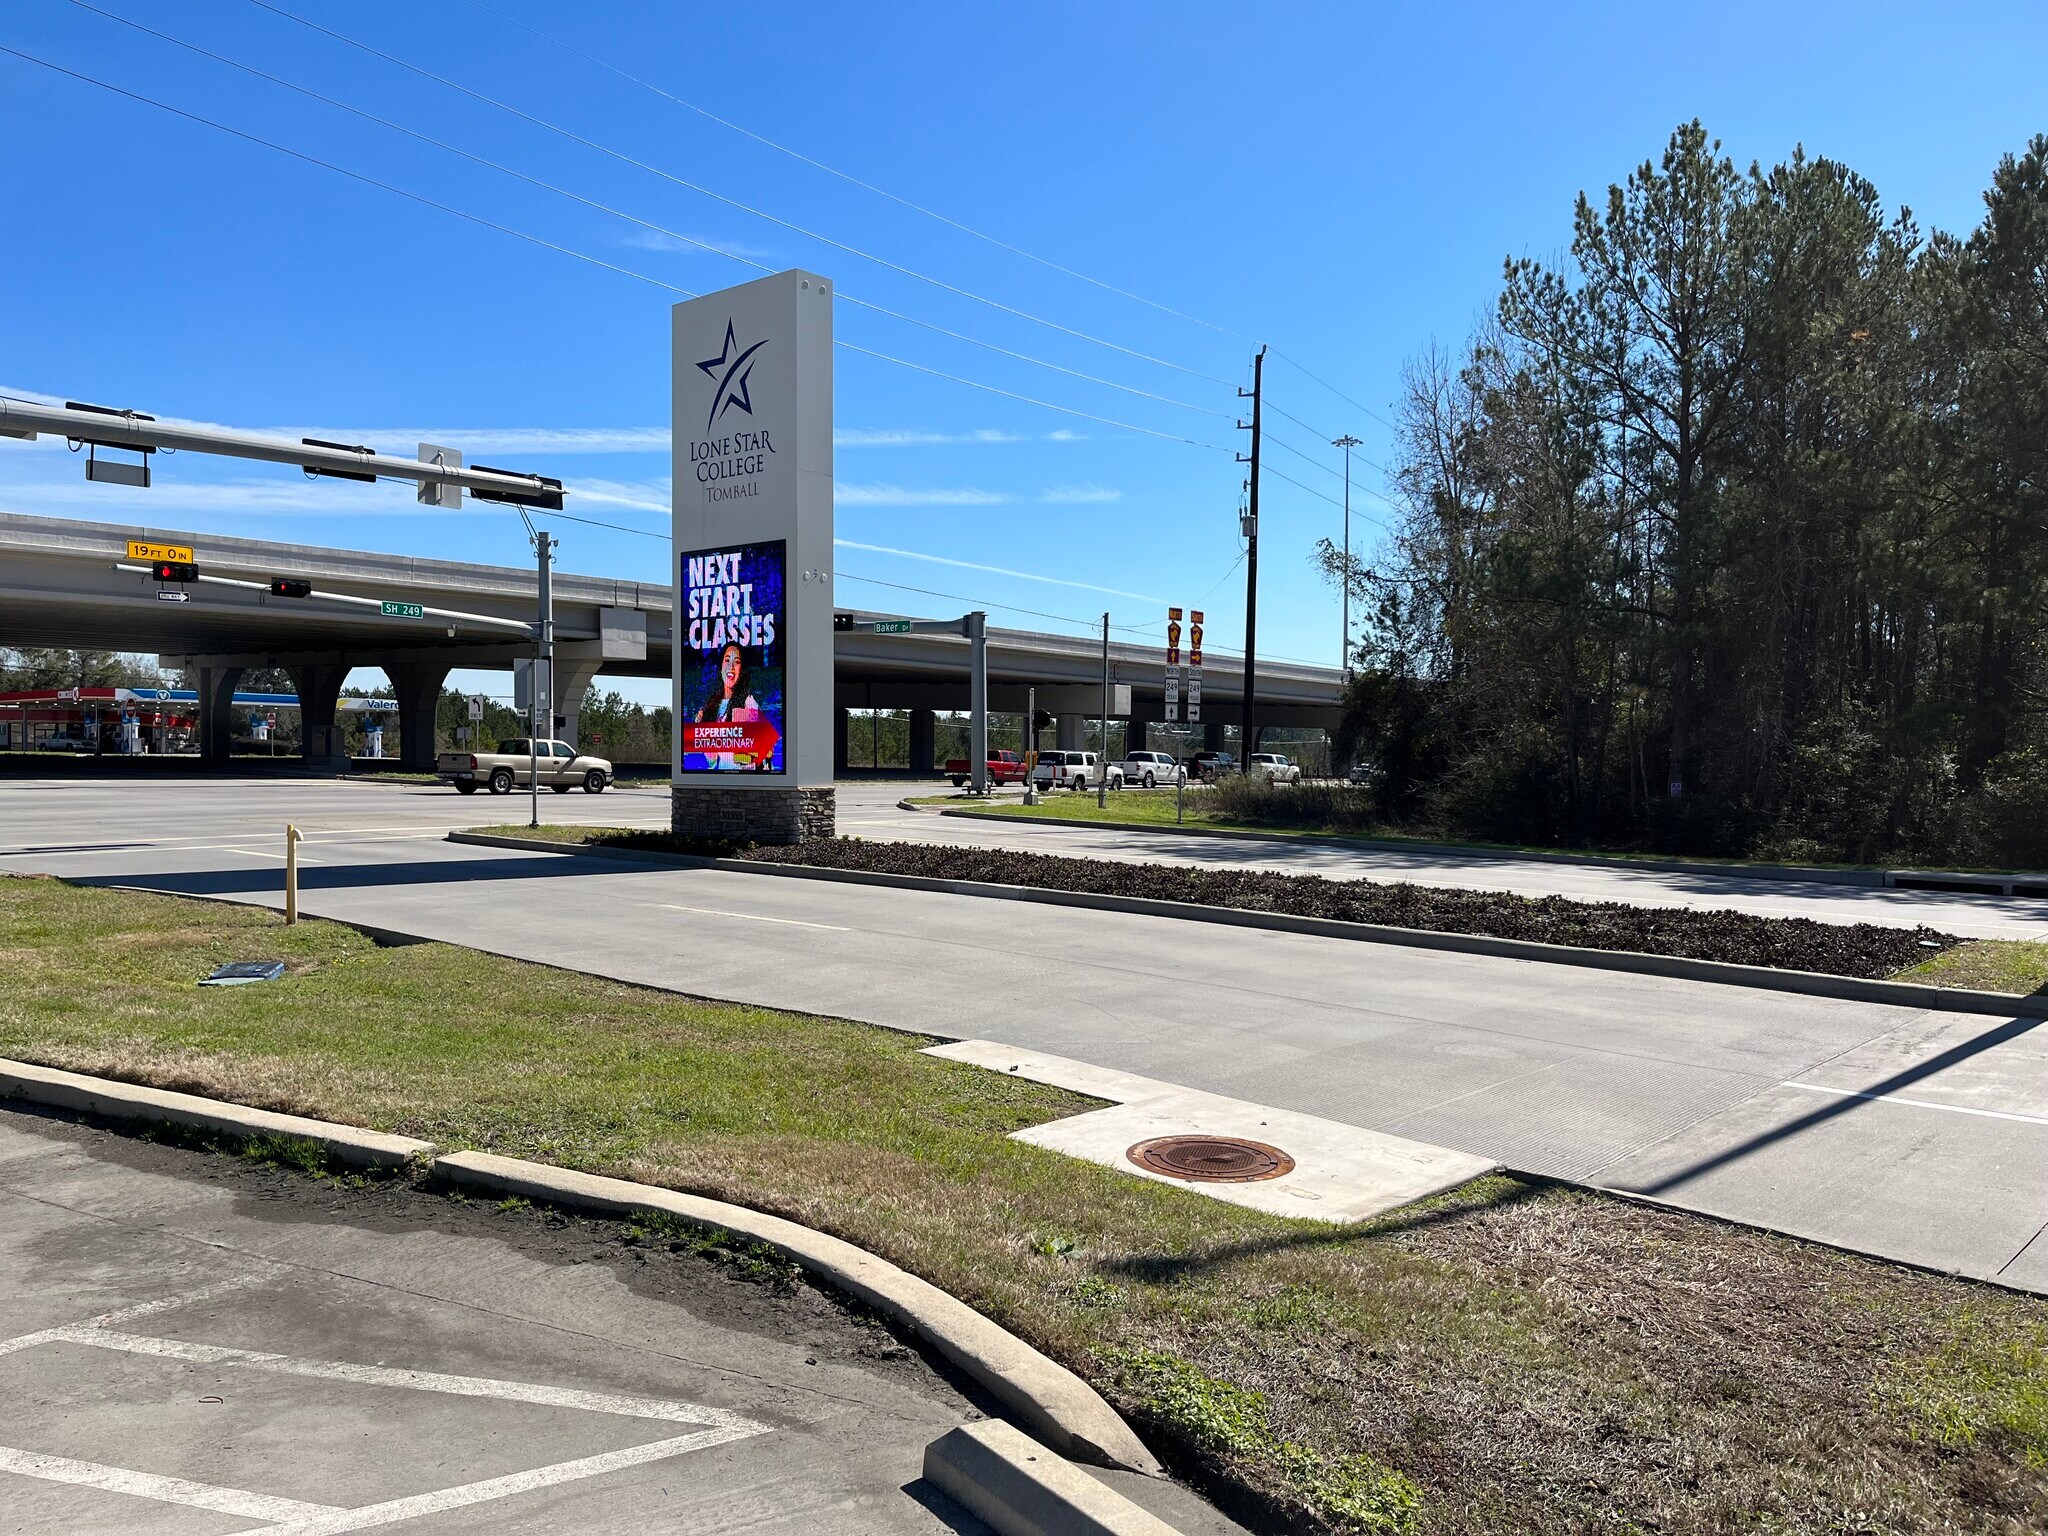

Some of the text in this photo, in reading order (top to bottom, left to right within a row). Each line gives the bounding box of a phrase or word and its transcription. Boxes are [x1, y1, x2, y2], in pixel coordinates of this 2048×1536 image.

[690, 430, 776, 462] LONE STAR
[697, 454, 764, 482] COLLEGE
[706, 482, 760, 503] TOMBALL
[134, 545, 148, 556] 19
[168, 549, 176, 559] 0
[689, 552, 742, 588] NEXT
[689, 583, 752, 619] START
[386, 604, 420, 616] SH 249
[689, 613, 775, 650] CLASSES
[876, 623, 898, 633] Baker
[1167, 683, 1177, 691] 249
[1190, 684, 1199, 692] 249
[694, 726, 743, 738] EXPERIENCE
[694, 738, 755, 749] EXTRAORDINARY
